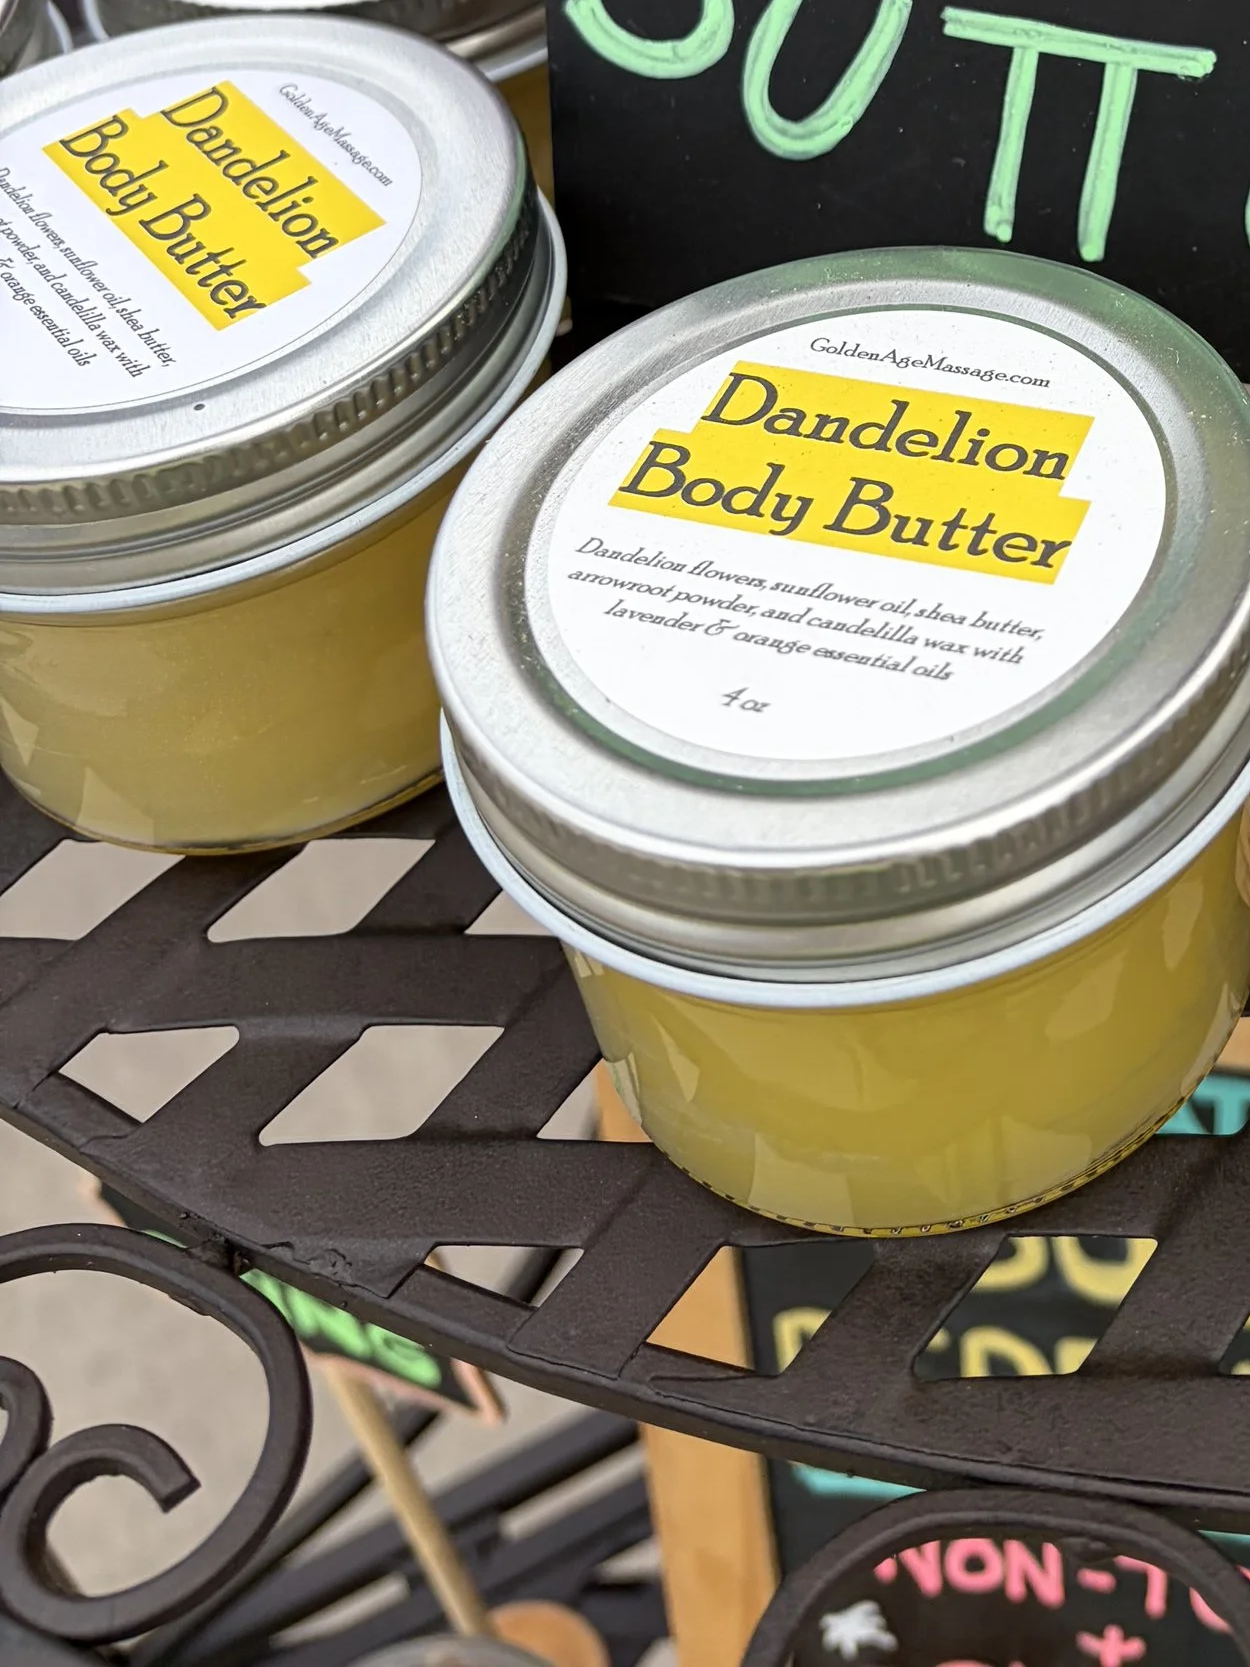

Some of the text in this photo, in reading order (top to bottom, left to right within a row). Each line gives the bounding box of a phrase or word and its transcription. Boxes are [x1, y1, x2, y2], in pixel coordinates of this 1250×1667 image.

[279, 82, 393, 187] GoldenAgeMassage.com
[160, 86, 340, 260] Dandelion
[28, 211, 66, 252] flowers,
[58, 114, 268, 320] Body Butter
[33, 261, 68, 284] and
[59, 245, 111, 294] sunflower
[0, 270, 37, 306] orange
[29, 303, 84, 349] essential
[67, 346, 98, 368] oils
[50, 280, 107, 333] candelilla
[101, 292, 132, 311] oil,
[115, 308, 145, 332] shea
[95, 329, 121, 354] wax
[114, 350, 152, 379] with
[137, 327, 177, 368] butter,
[809, 336, 1051, 388] GoldenAgeMassage.com
[700, 371, 1070, 482] Dandelion
[617, 438, 1073, 570] Body Butter
[574, 536, 1046, 642] Dandelion flowers, sunflower oil, shea butter,
[567, 568, 1026, 666] arrowroot powder, and candelilla wax with
[603, 598, 955, 682] lavender & orange essential oils
[720, 685, 772, 714] 4 oz
